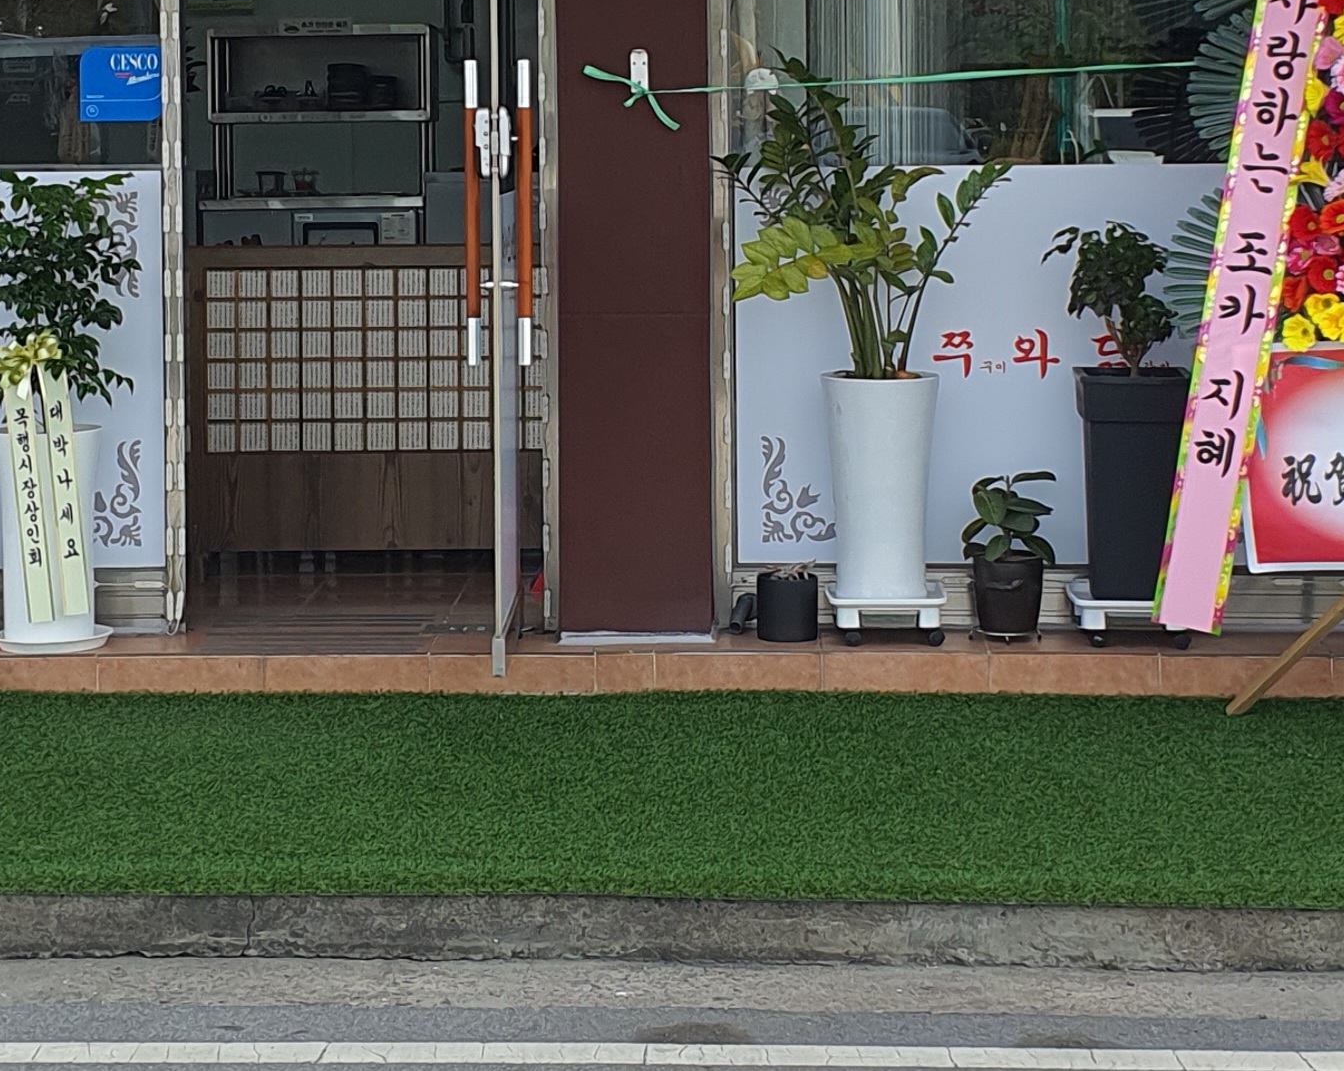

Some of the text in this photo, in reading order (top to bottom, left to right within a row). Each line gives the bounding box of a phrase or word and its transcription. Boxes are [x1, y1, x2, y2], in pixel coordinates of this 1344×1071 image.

[109, 52, 159, 71] CESCO
[1217, 231, 1273, 335] 조카
[1192, 369, 1244, 479] 지혜
[49, 399, 80, 560] 대박나세요
